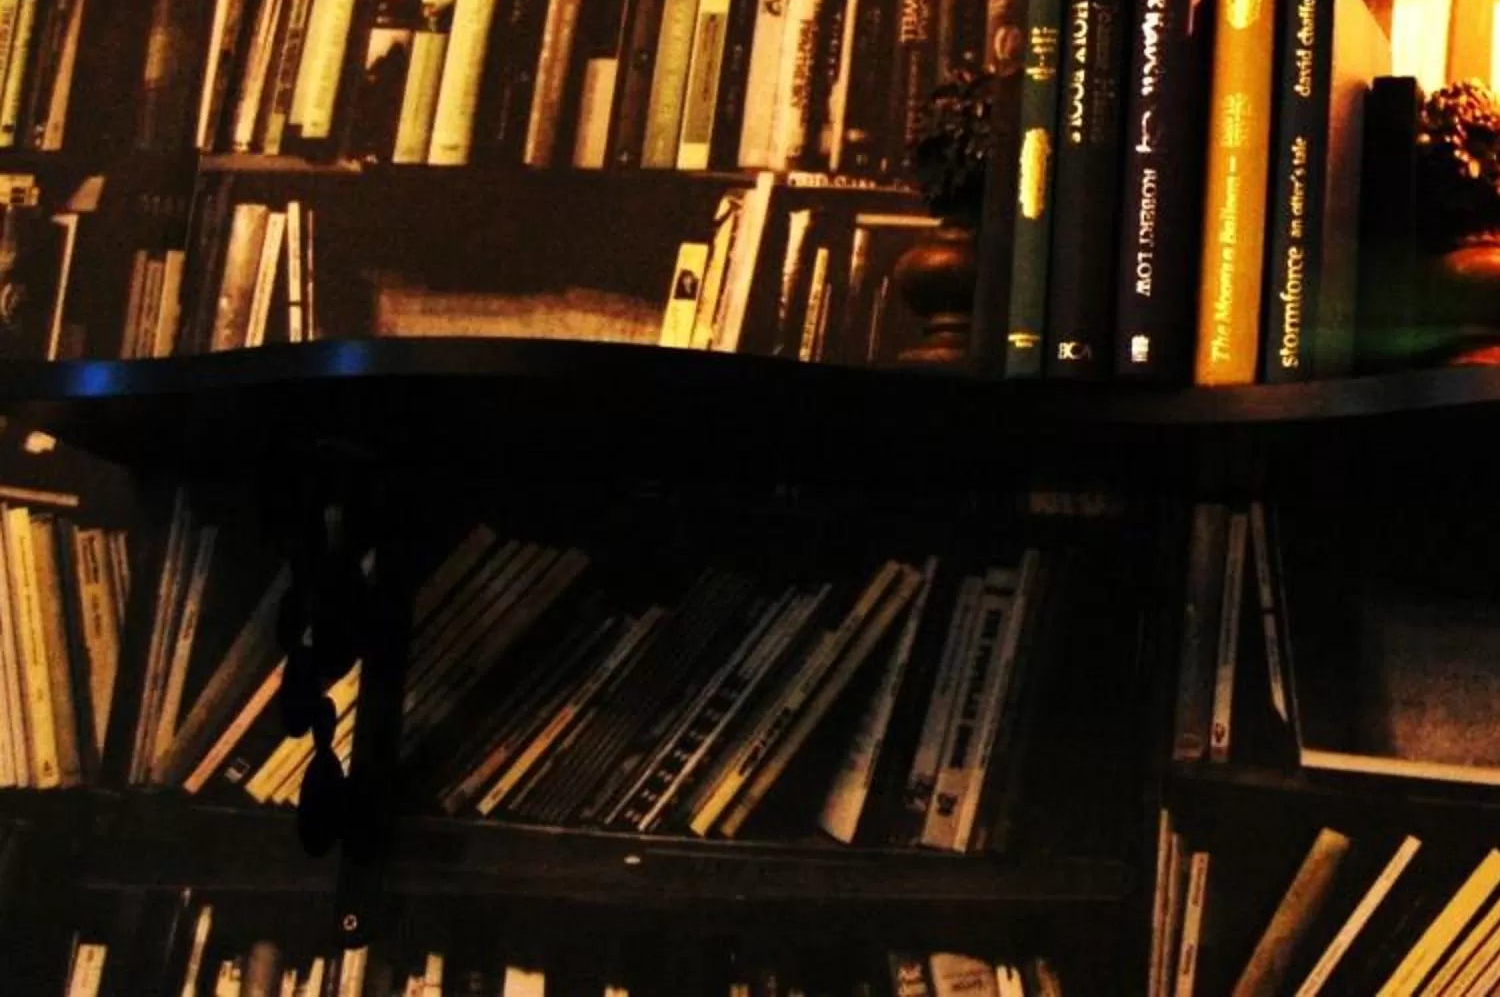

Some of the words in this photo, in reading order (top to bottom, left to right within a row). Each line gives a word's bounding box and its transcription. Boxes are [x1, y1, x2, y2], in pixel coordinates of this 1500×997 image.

[1294, 48, 1313, 97] david
[1291, 136, 1307, 166] tale
[1139, 168, 1158, 247] ROBERT
[1289, 168, 1306, 214] otter's
[1291, 218, 1303, 238] an
[1136, 251, 1153, 297] LOW
[1280, 246, 1303, 368] stormforce
[1209, 324, 1233, 364] The
